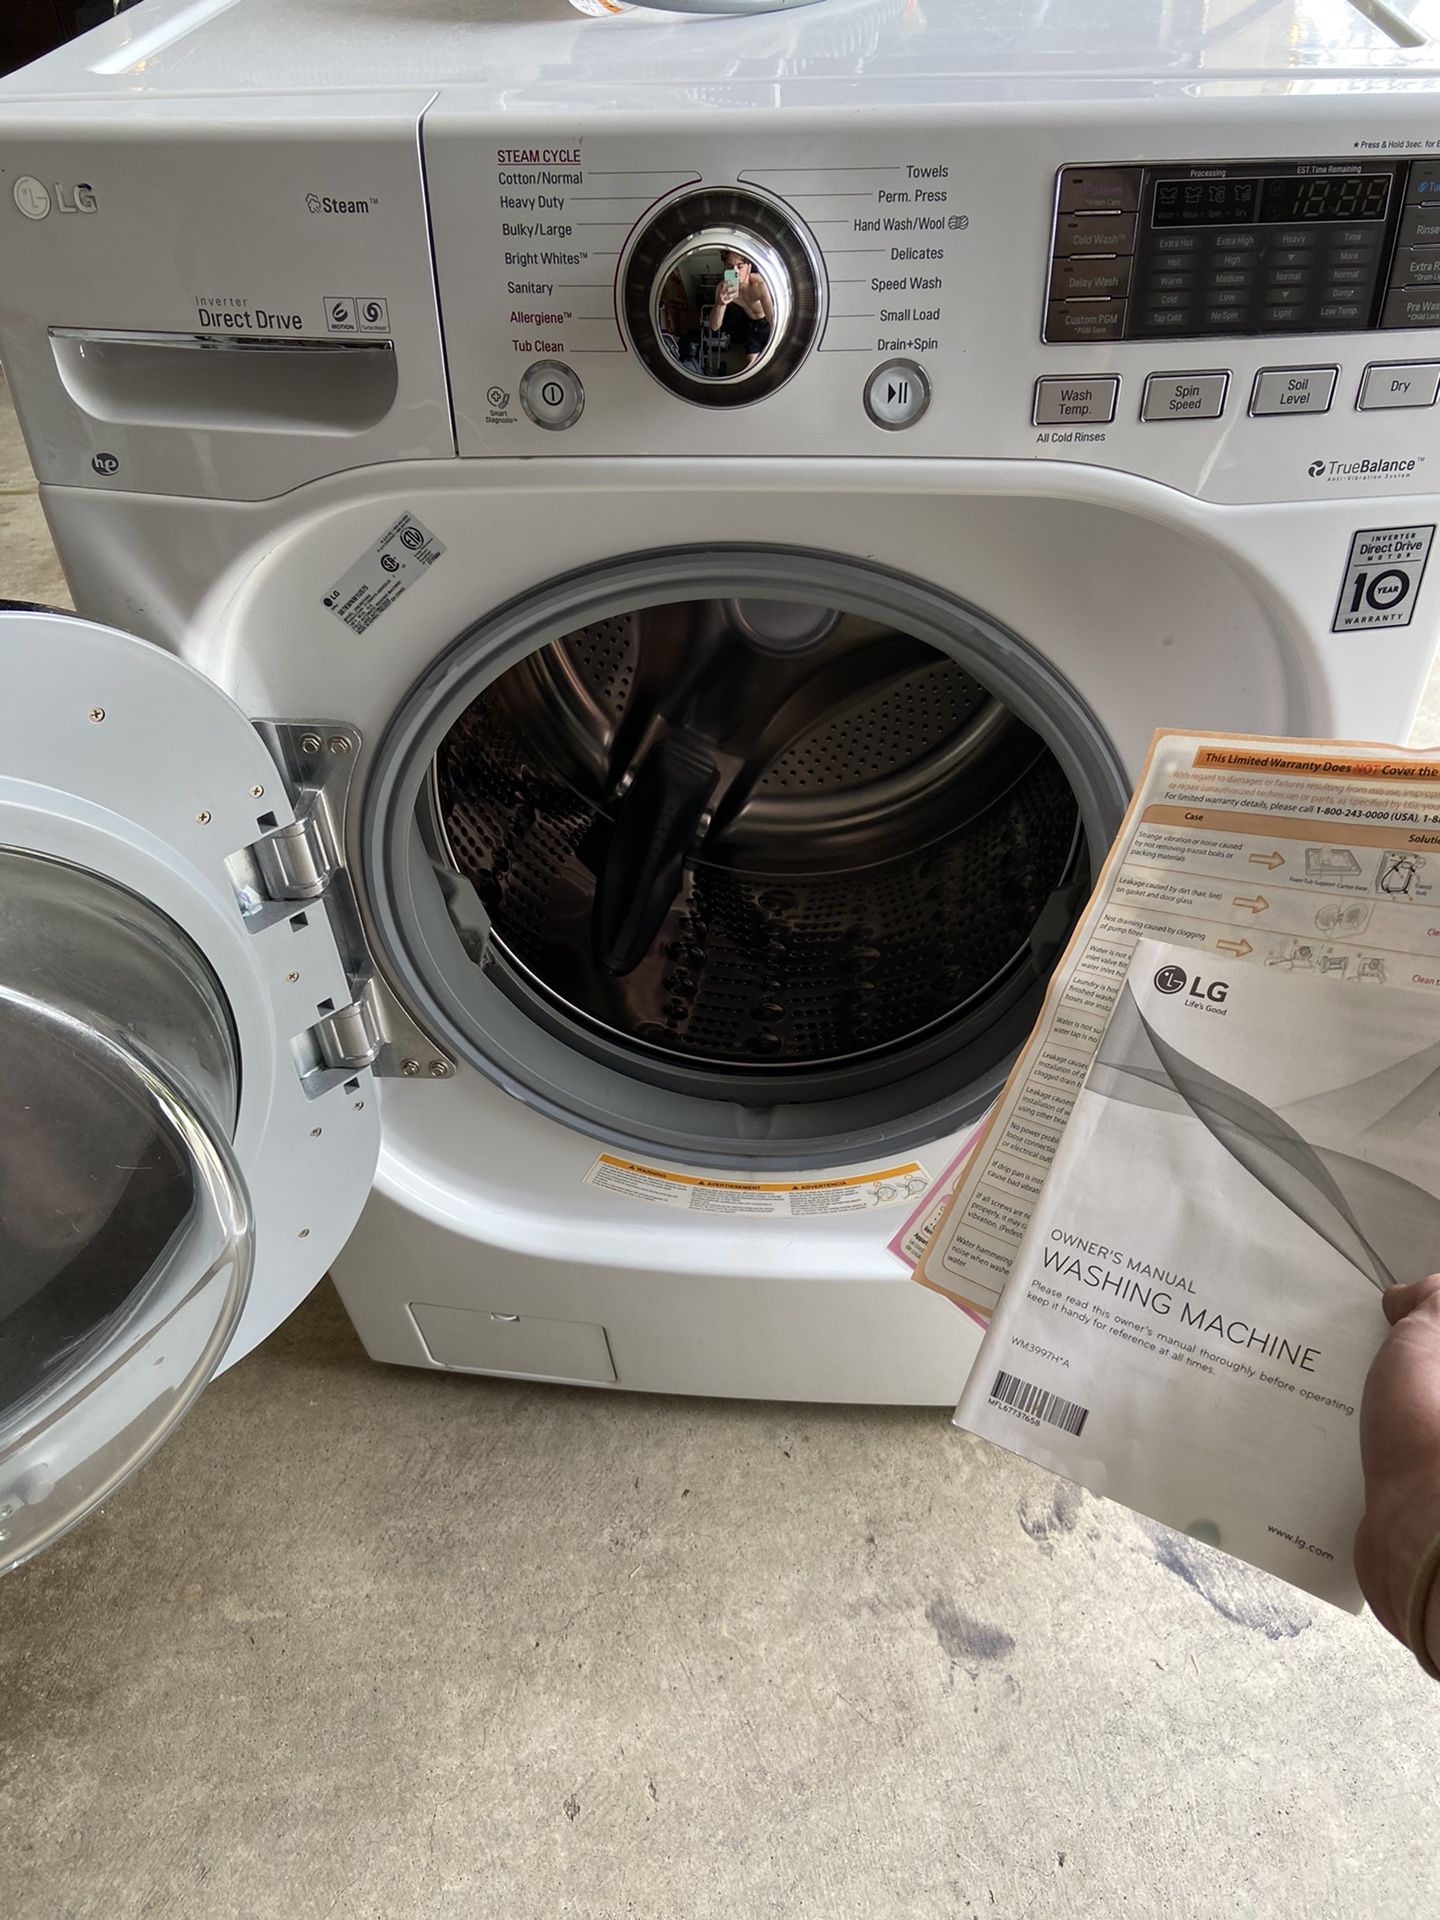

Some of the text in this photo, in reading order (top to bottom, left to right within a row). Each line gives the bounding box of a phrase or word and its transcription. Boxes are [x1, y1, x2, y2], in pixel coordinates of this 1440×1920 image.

[1361, 141, 1380, 149] Press
[1425, 140, 1435, 148] for
[497, 149, 581, 163] STEAM CYCLE
[906, 165, 949, 178] Towels
[1190, 169, 1227, 178] Processing
[1312, 166, 1327, 174] Time
[1328, 165, 1362, 174] Remaining
[498, 171, 583, 185] Cotton/Normal
[55, 182, 98, 214] LG
[878, 189, 948, 204] Perm. Press
[500, 195, 565, 211] Heavy Duty
[502, 222, 572, 238] Bulky/Large
[853, 216, 946, 232] Hand Wash/Wool
[1073, 235, 1092, 246] Cold
[1159, 238, 1194, 248] Extra Hot
[1216, 235, 1254, 246] Extra High
[1282, 234, 1306, 244] Heavy
[1344, 232, 1362, 242] Time
[504, 252, 539, 268] Bright
[890, 248, 944, 260] Delicates
[1224, 255, 1241, 264] High
[1340, 252, 1359, 260] More
[1167, 257, 1181, 266] Hot
[1410, 262, 1432, 272] Extra
[1216, 274, 1244, 283] Medium
[1276, 272, 1302, 281] Normal
[1333, 270, 1359, 280] Normal
[871, 276, 942, 293] Speed Wash
[1069, 277, 1118, 288] Delay Wash
[1160, 277, 1182, 286] Warm
[507, 281, 554, 296] Sanitary
[1332, 288, 1353, 298] Damp
[196, 296, 248, 307] Inverter
[1161, 294, 1177, 304] Cold
[1219, 292, 1236, 301] Low
[1272, 308, 1292, 318] Light
[1320, 306, 1336, 316] Low
[1406, 302, 1421, 312] Pre
[198, 309, 302, 330] Direct Drive
[880, 308, 940, 322] Small Load
[1064, 314, 1118, 326] Custom PGM
[1167, 313, 1182, 322] Cold
[1210, 310, 1238, 321] No Spin
[512, 340, 564, 352] Tub Clean
[877, 338, 938, 352] Drain+Spin
[1288, 378, 1309, 391] Soil
[1390, 380, 1411, 393] Dry
[1060, 390, 1092, 402] Wash
[1174, 385, 1200, 399] Spin
[1280, 392, 1310, 405] Level
[1058, 404, 1092, 416] Temp.
[1168, 399, 1202, 412] Speed
[1036, 432, 1106, 443] All Cold Rinses
[1371, 532, 1416, 542] INVERTER
[1360, 541, 1422, 555] Direct Drive
[1368, 552, 1412, 562] MOTOR
[1350, 569, 1410, 612] 10
[1377, 586, 1400, 594] YEAR
[1344, 613, 1404, 625] WARRANTY
[1206, 753, 1226, 762] This
[1228, 754, 1268, 767] Limited
[1270, 758, 1322, 773] Warranty
[1322, 762, 1352, 773] Does
[1382, 765, 1418, 776] Cover
[1418, 767, 1438, 777] the
[1164, 792, 1176, 800] For
[1178, 792, 1204, 802] limited
[1205, 796, 1240, 807] warranty
[1269, 802, 1298, 812] please
[1316, 806, 1389, 820] 1-800-243-0000
[1184, 812, 1204, 822] Case
[1138, 831, 1162, 841] Strange
[1164, 835, 1192, 844] vibration
[1200, 840, 1218, 848] noise
[1218, 842, 1243, 850] caused
[1130, 849, 1186, 862] packing materials
[1118, 877, 1190, 894] Leakage caused by dirt
[1412, 974, 1434, 985] Clean
[1189, 976, 1230, 1002] LG
[1184, 1000, 1228, 1016] Life's Good
[1026, 1086, 1074, 1108] Leakage caused
[635, 1167, 667, 1179] WARNING
[800, 1180, 848, 1190] ADVERTENCIA
[952, 1246, 989, 1266] noise when
[956, 1235, 976, 1248] Water
[976, 1244, 1013, 1266] hammering
[948, 1255, 966, 1267] water
[1050, 1229, 1196, 1294] OWNER'S MANUAL
[1044, 1246, 1322, 1372] WASHING MACHINE
[1026, 1290, 1216, 1376] keep it handy for reference at all times.
[1031, 1280, 1354, 1416] Please read this owner's manual thoroughly before operating
[988, 1397, 1040, 1427] MFL67737658
[1268, 1524, 1334, 1562] www.lg.com
